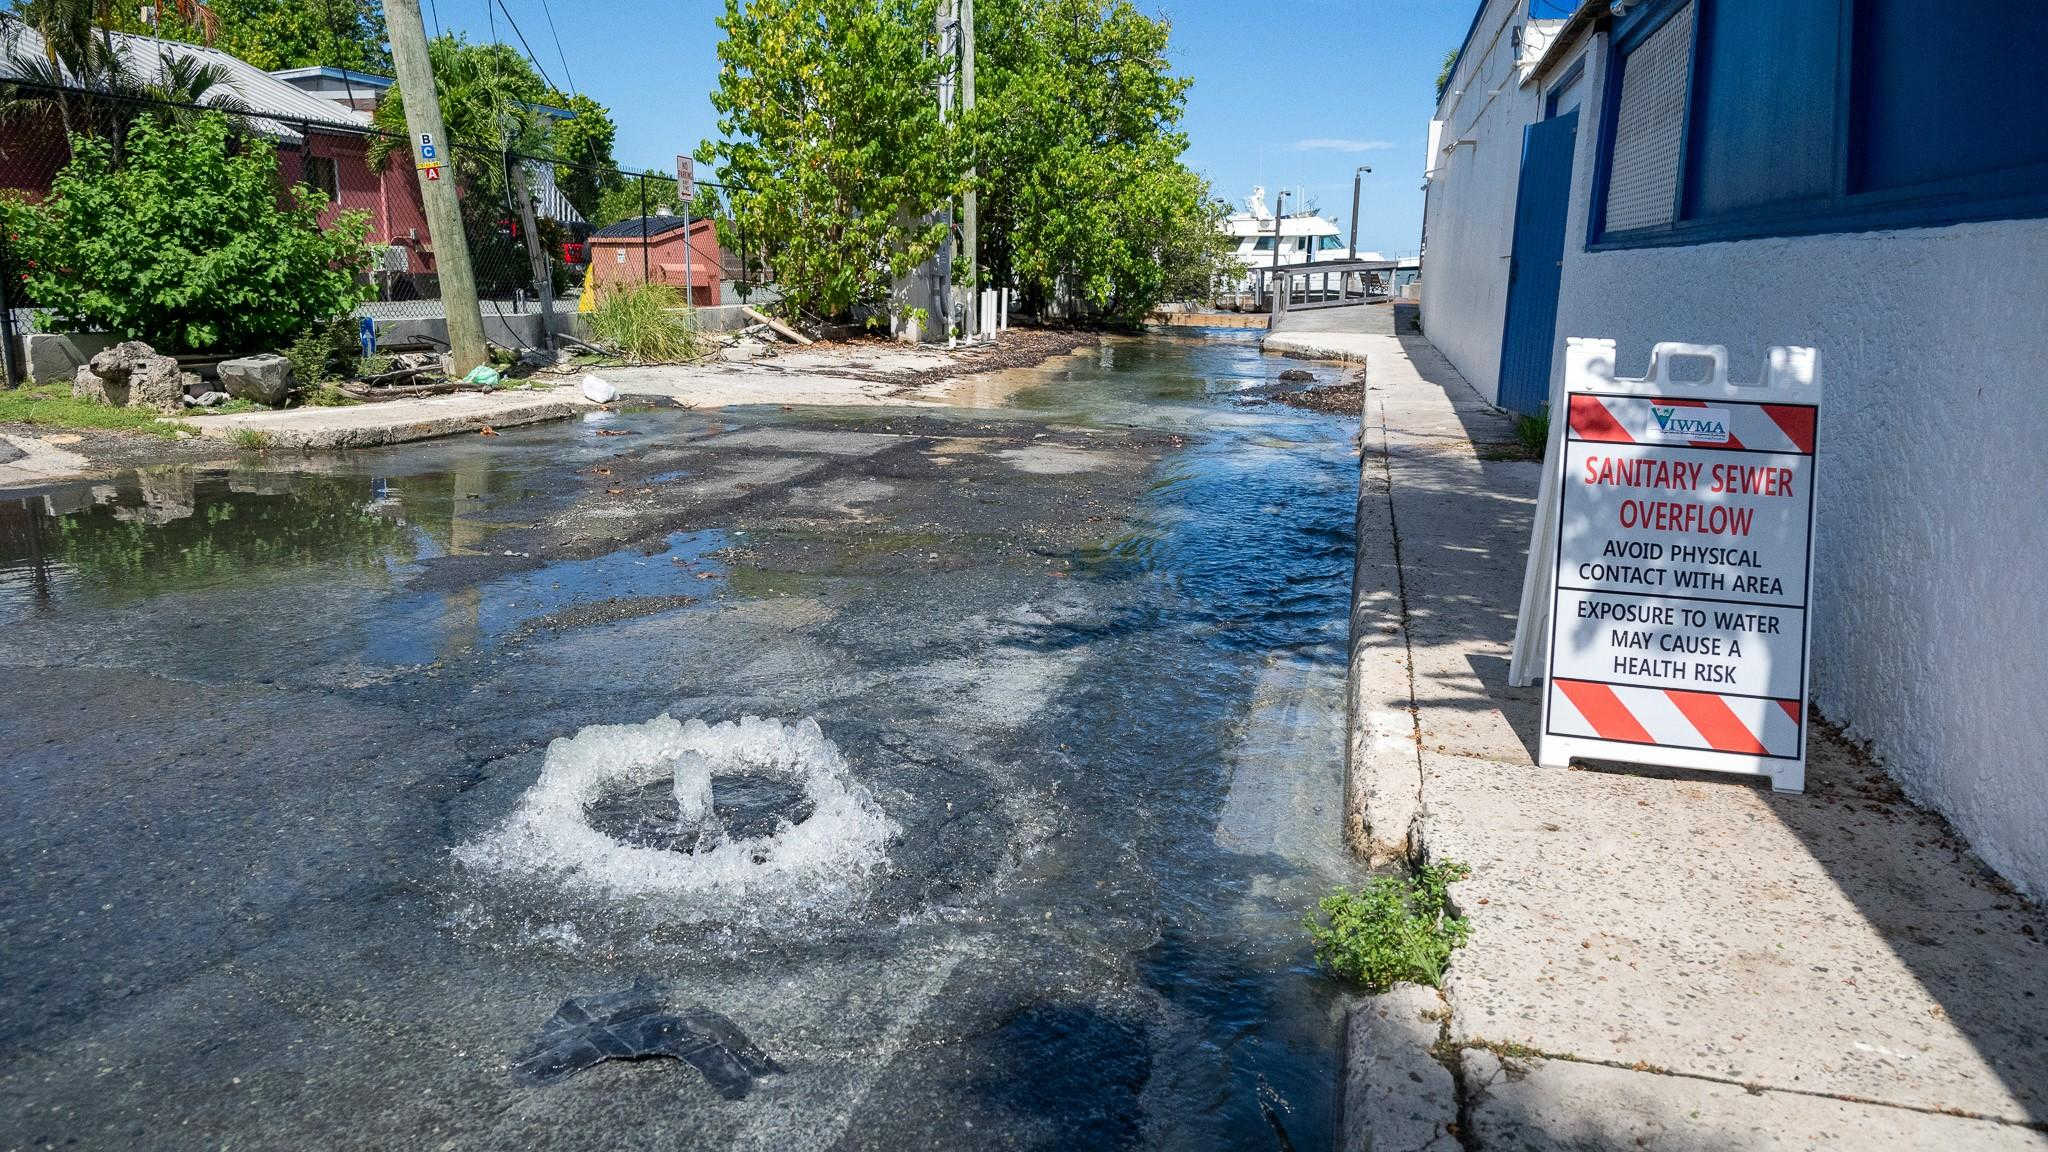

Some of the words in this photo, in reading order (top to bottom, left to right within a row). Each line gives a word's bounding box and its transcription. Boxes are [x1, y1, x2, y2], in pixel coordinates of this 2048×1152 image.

[421, 134, 431, 145] B
[423, 147, 433, 157] C
[428, 168, 438, 179] A
[1651, 408, 1726, 434] VIWMA
[1584, 456, 1703, 491] SANITARY
[1711, 463, 1794, 498] SEWER
[1619, 500, 1754, 536] OVERFLOW
[1603, 540, 1663, 560] AVOID
[1671, 545, 1762, 568] PHYSICAL
[1579, 563, 1667, 586] CONTACT
[1673, 569, 1724, 591] WITH
[1732, 575, 1784, 596] AREA
[1577, 600, 1674, 625] EXPOSURE
[1681, 609, 1707, 628] TO
[1714, 611, 1780, 634] WATER
[1611, 629, 1653, 650] MAY
[1660, 633, 1721, 656] CAUSE
[1728, 640, 1742, 657] A
[1613, 656, 1686, 679] HEALTH
[1694, 664, 1736, 684] RISK
